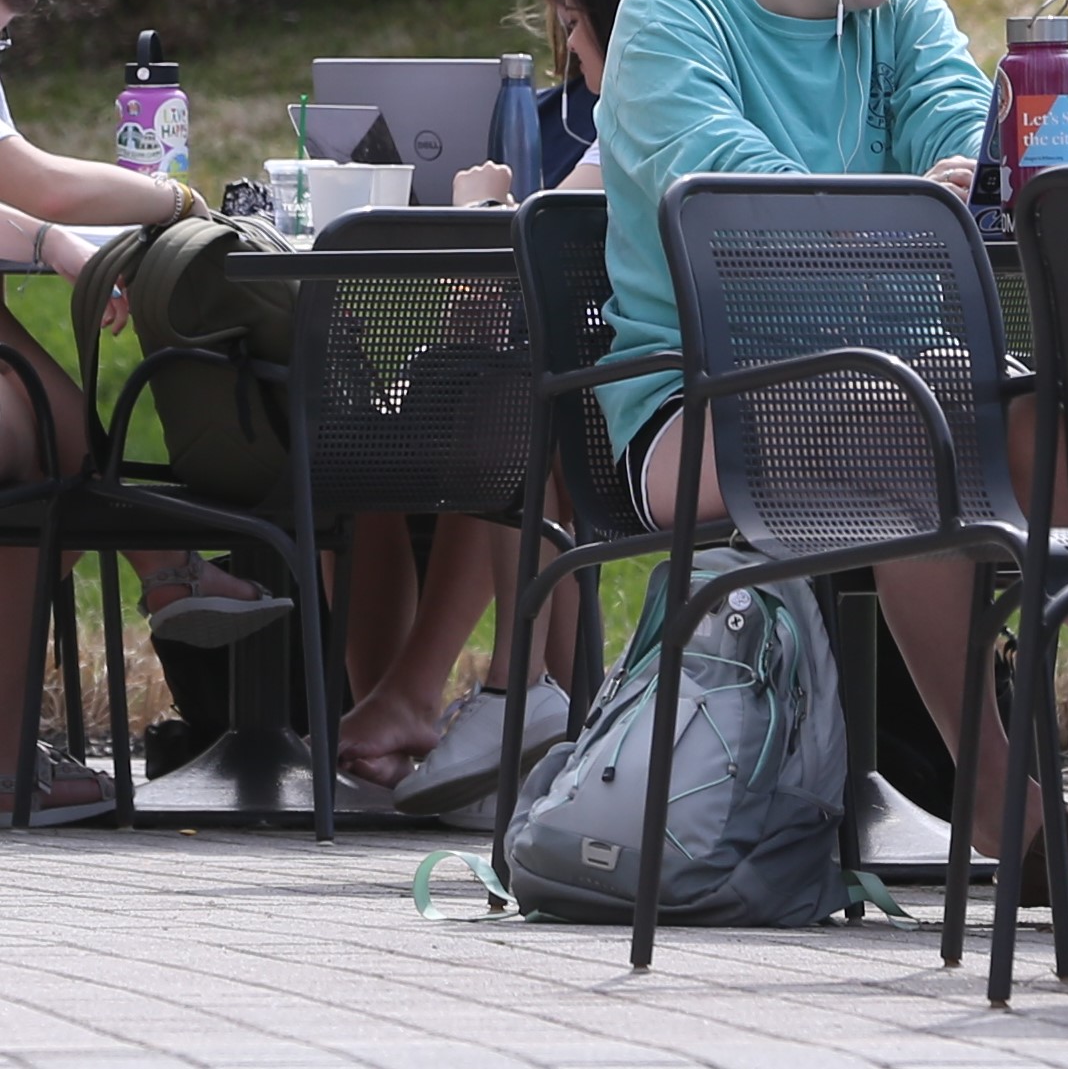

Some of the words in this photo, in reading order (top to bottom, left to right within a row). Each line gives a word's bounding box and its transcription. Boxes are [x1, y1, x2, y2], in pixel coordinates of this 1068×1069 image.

[1023, 111, 1059, 126] Let's
[418, 141, 439, 149] DELL
[1023, 132, 1049, 146] the
